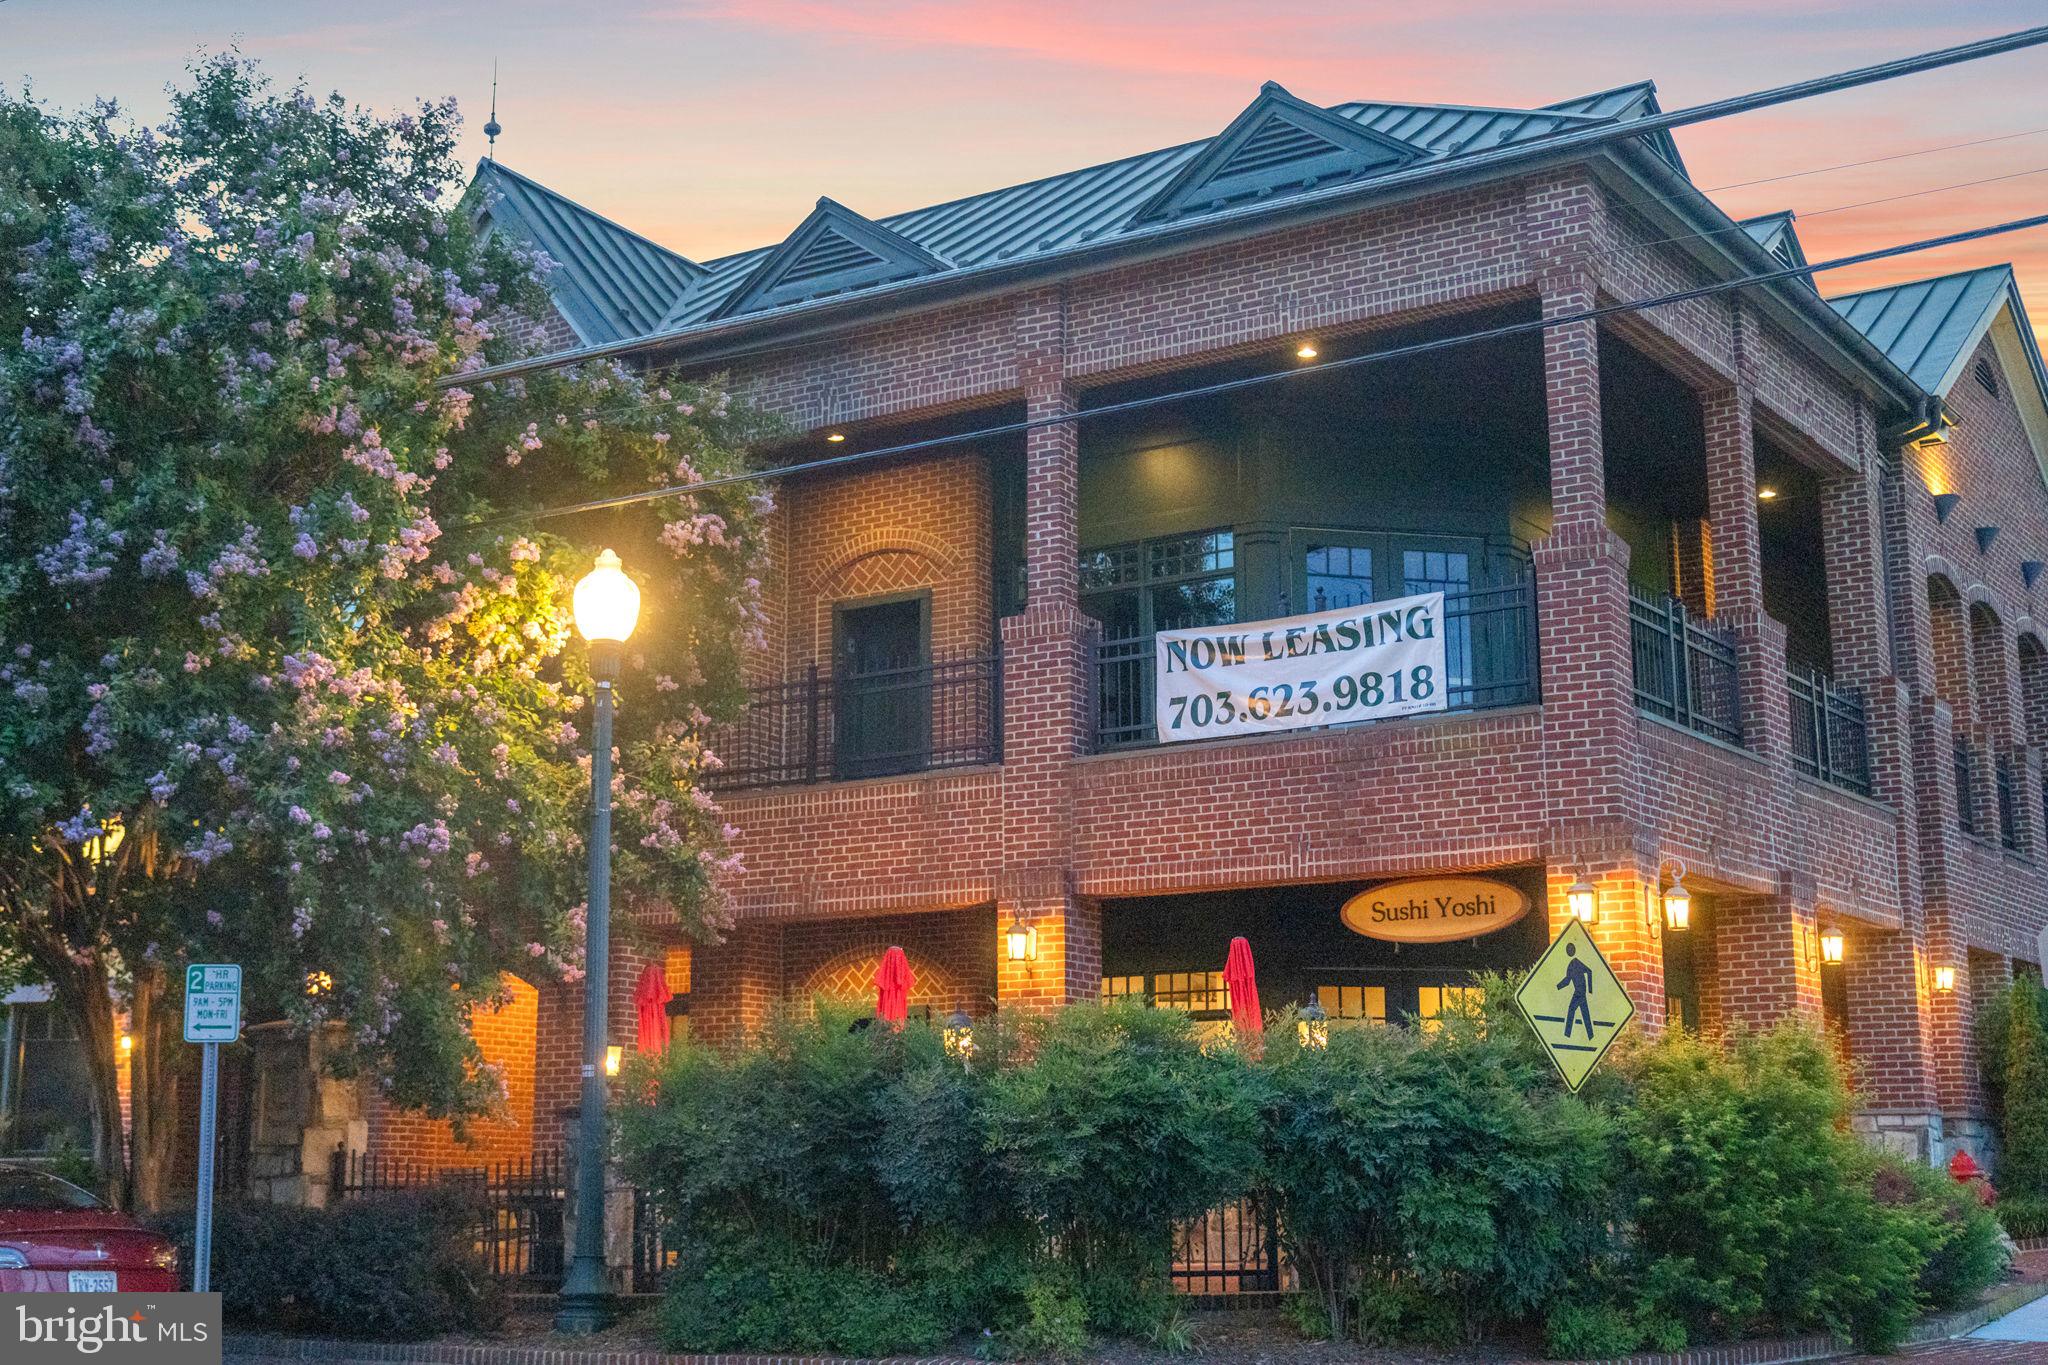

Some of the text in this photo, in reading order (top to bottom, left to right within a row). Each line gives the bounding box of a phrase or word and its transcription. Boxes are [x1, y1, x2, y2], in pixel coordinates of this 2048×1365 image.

[1166, 605, 1435, 673] NOW LEASING
[1168, 664, 1435, 730] 703.623.9818
[1371, 894, 1496, 923] Sushi Yoshi
[190, 970, 229, 990] 2 HR
[205, 981, 237, 991] PARKING
[197, 1010, 228, 1020] MON-FRI
